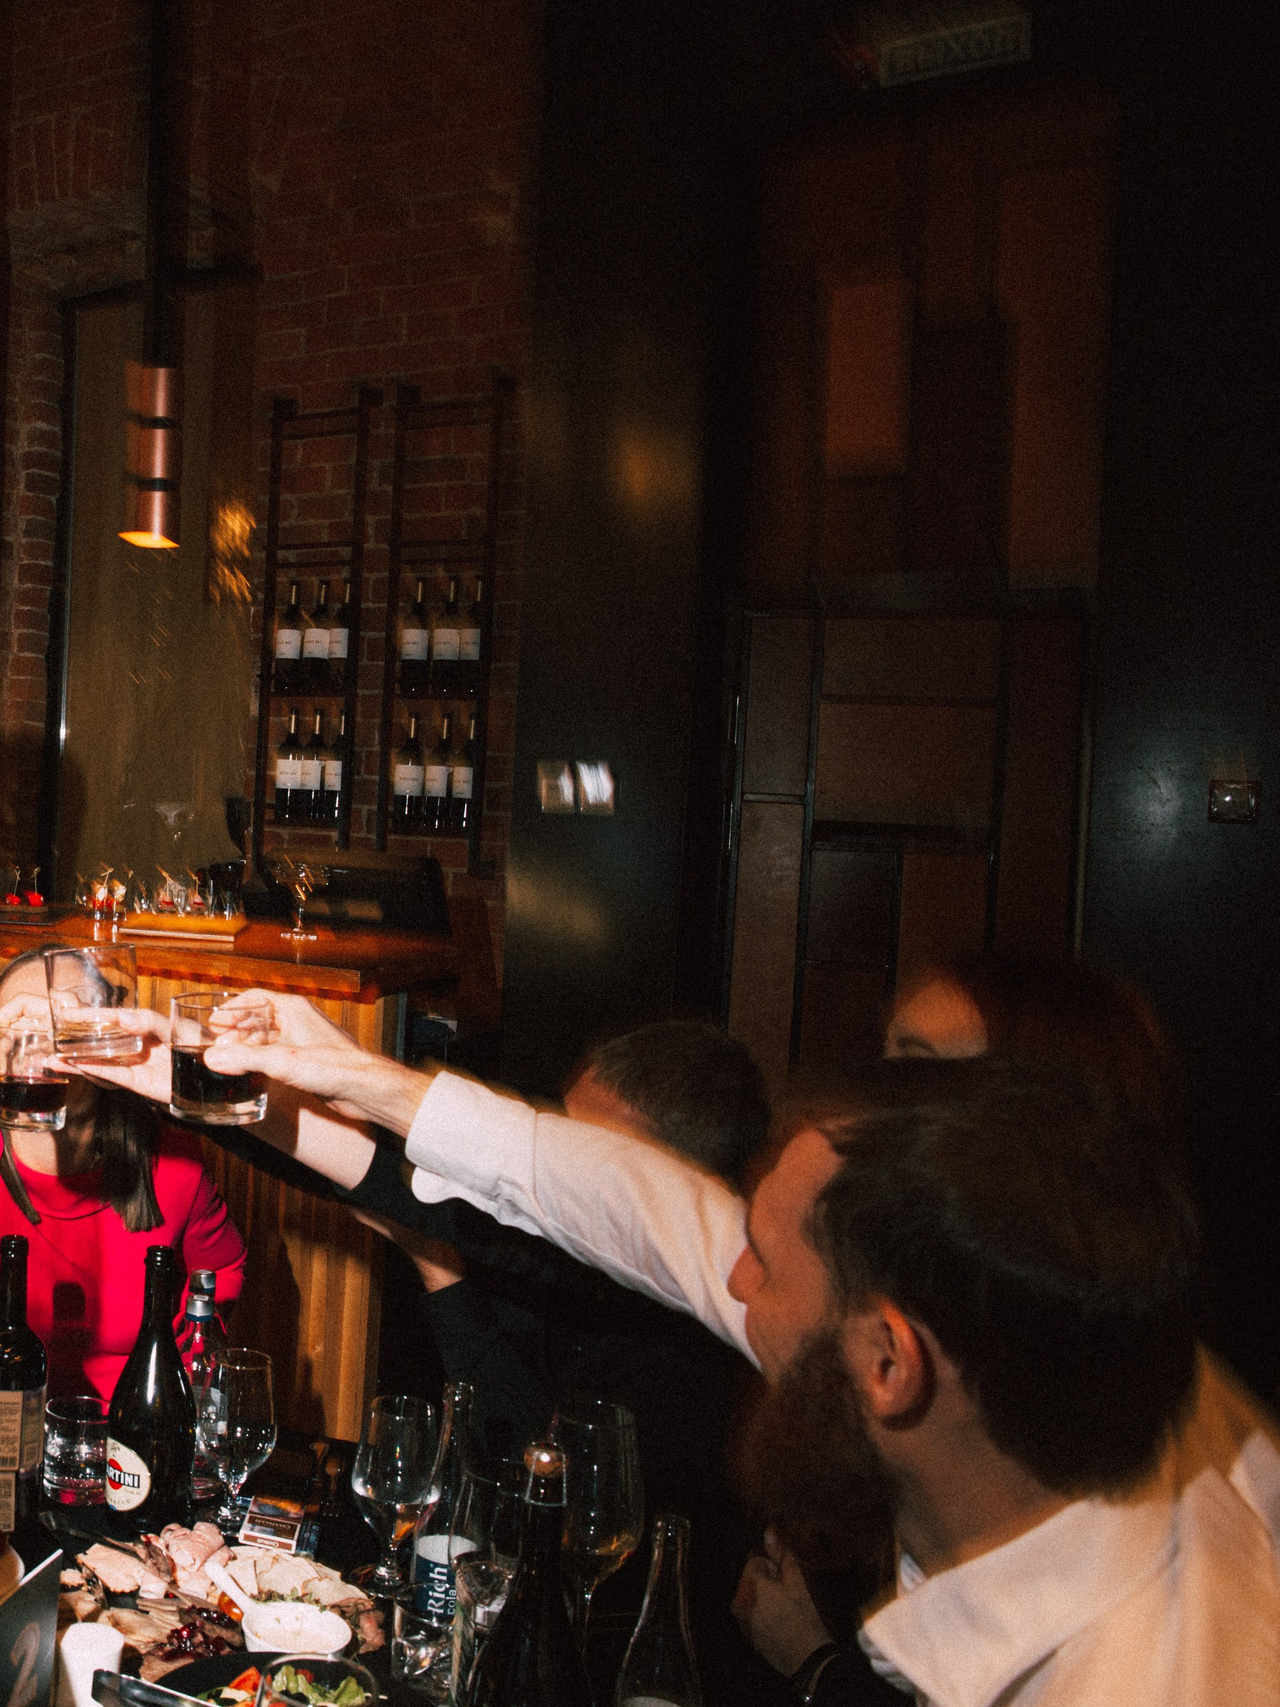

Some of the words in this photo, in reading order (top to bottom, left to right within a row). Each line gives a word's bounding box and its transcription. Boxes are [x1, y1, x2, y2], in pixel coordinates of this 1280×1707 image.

[107, 1463, 139, 1488] ARTINI
[427, 1566, 448, 1614] Rich
[446, 1589, 457, 1615] cola
